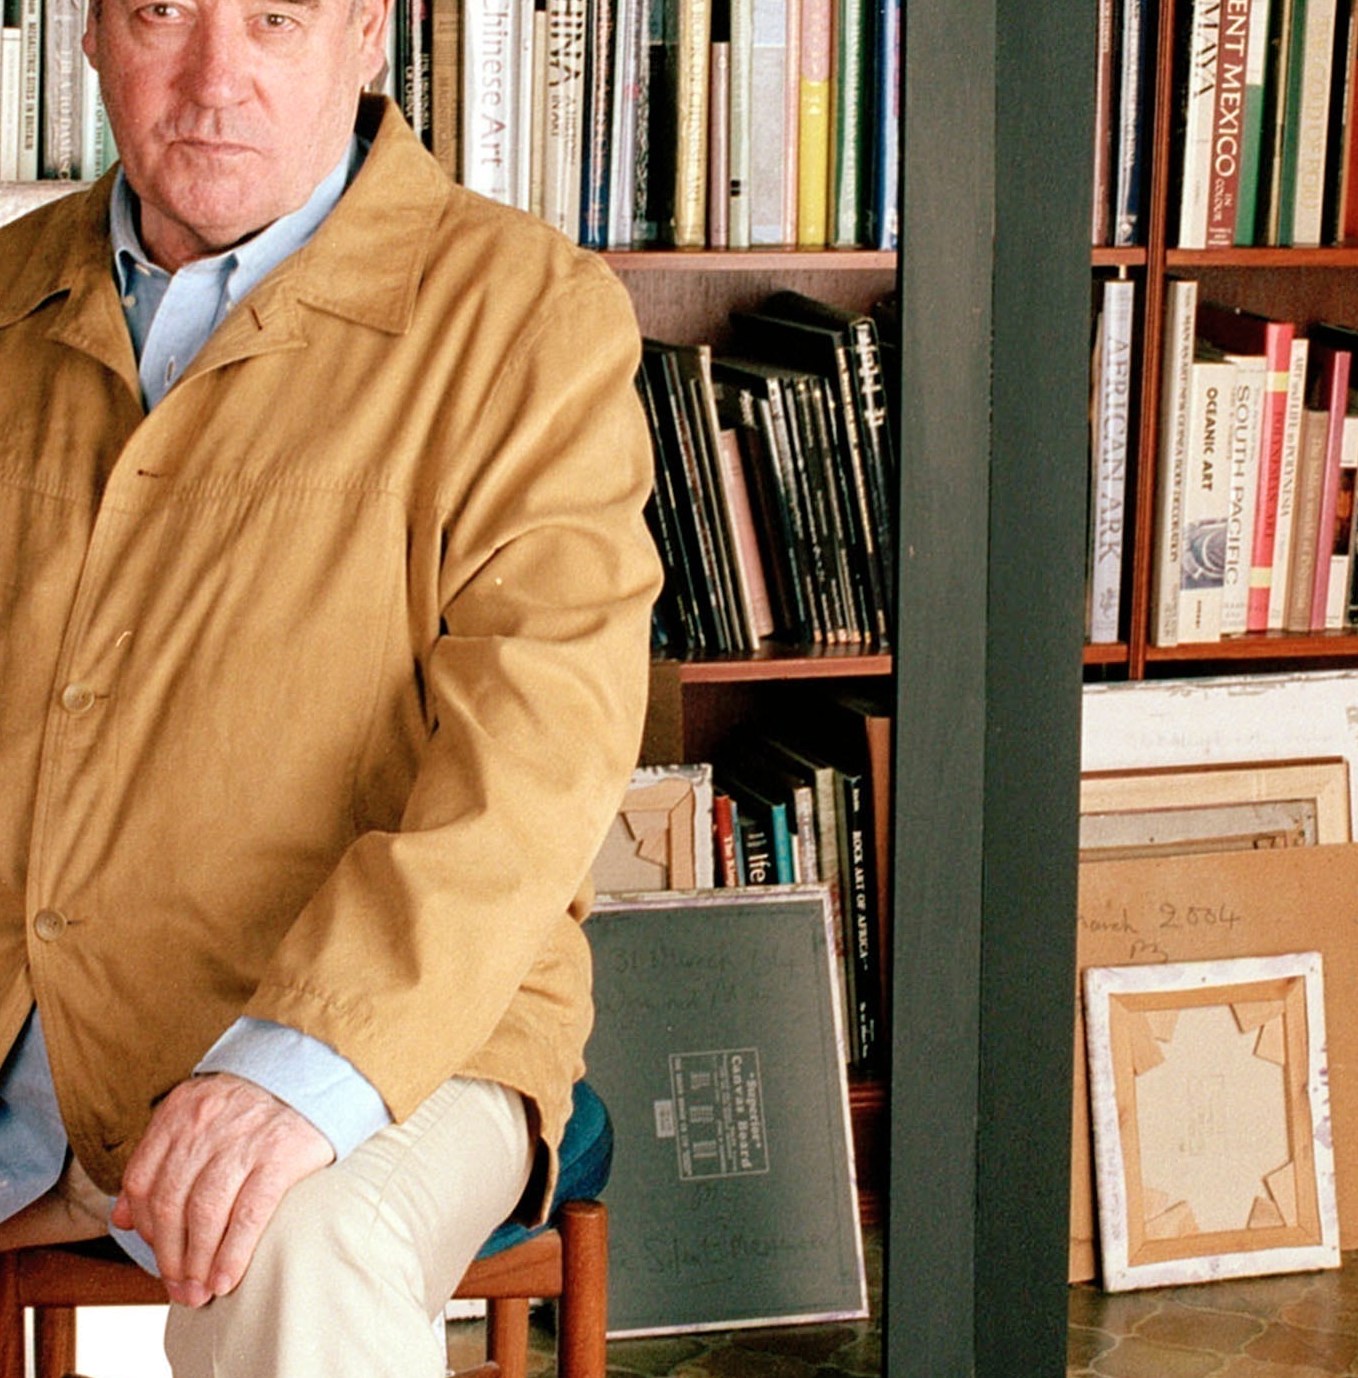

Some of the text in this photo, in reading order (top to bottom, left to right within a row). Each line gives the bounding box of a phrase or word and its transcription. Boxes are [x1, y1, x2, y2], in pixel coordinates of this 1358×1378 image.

[479, 117, 507, 168] Art
[1215, 61, 1244, 179] MEXICO
[1098, 338, 1129, 564] AFRICAN ARK
[1201, 386, 1219, 493] OCEANIC ART
[853, 829, 869, 960] ROCK ART OF AFRICA
[1158, 902, 1241, 929] 2004
[731, 1055, 752, 1168] Canvas Board
